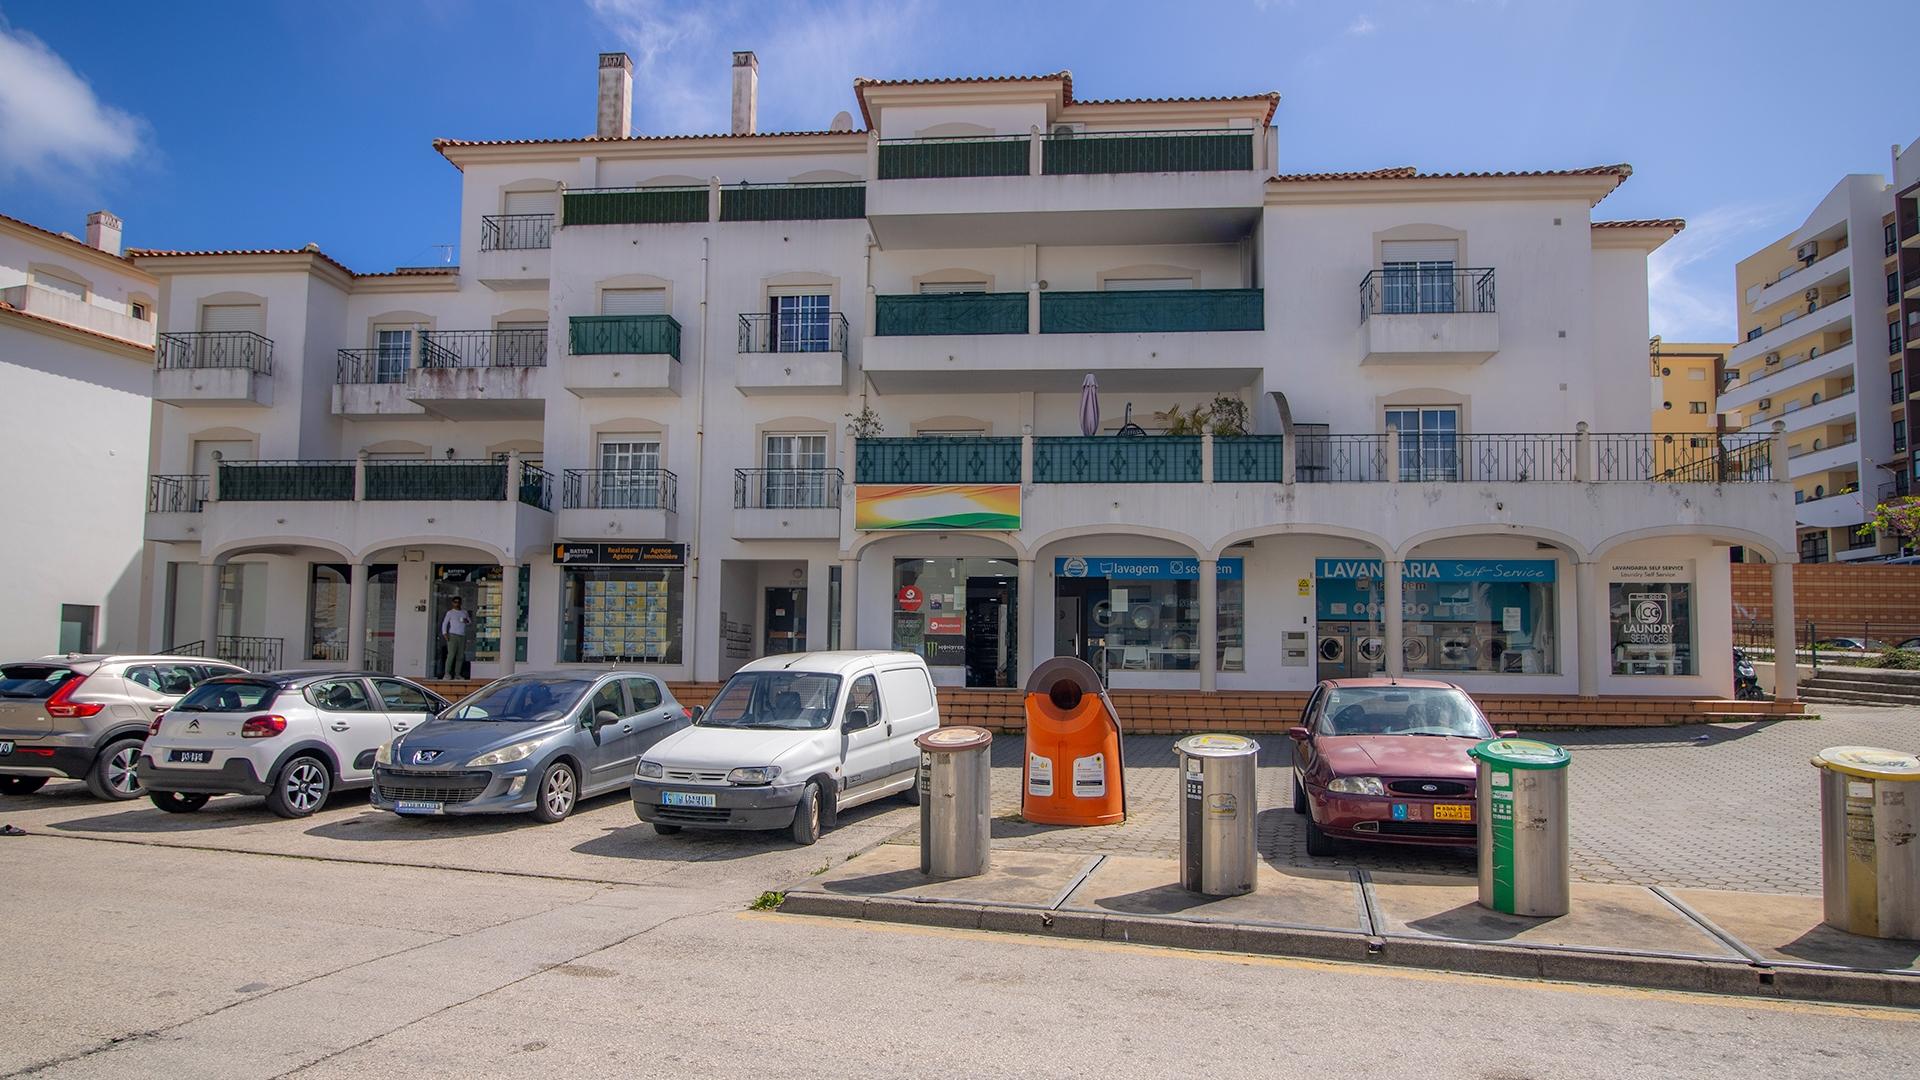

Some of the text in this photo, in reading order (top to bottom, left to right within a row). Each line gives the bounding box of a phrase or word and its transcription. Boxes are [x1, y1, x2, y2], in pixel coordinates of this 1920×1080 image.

[1114, 562, 1159, 576] lavagem
[1324, 562, 1440, 578] LAVANARIA
[1624, 624, 1674, 634] LAUNDRY
[1630, 634, 1669, 643] SERVICES
